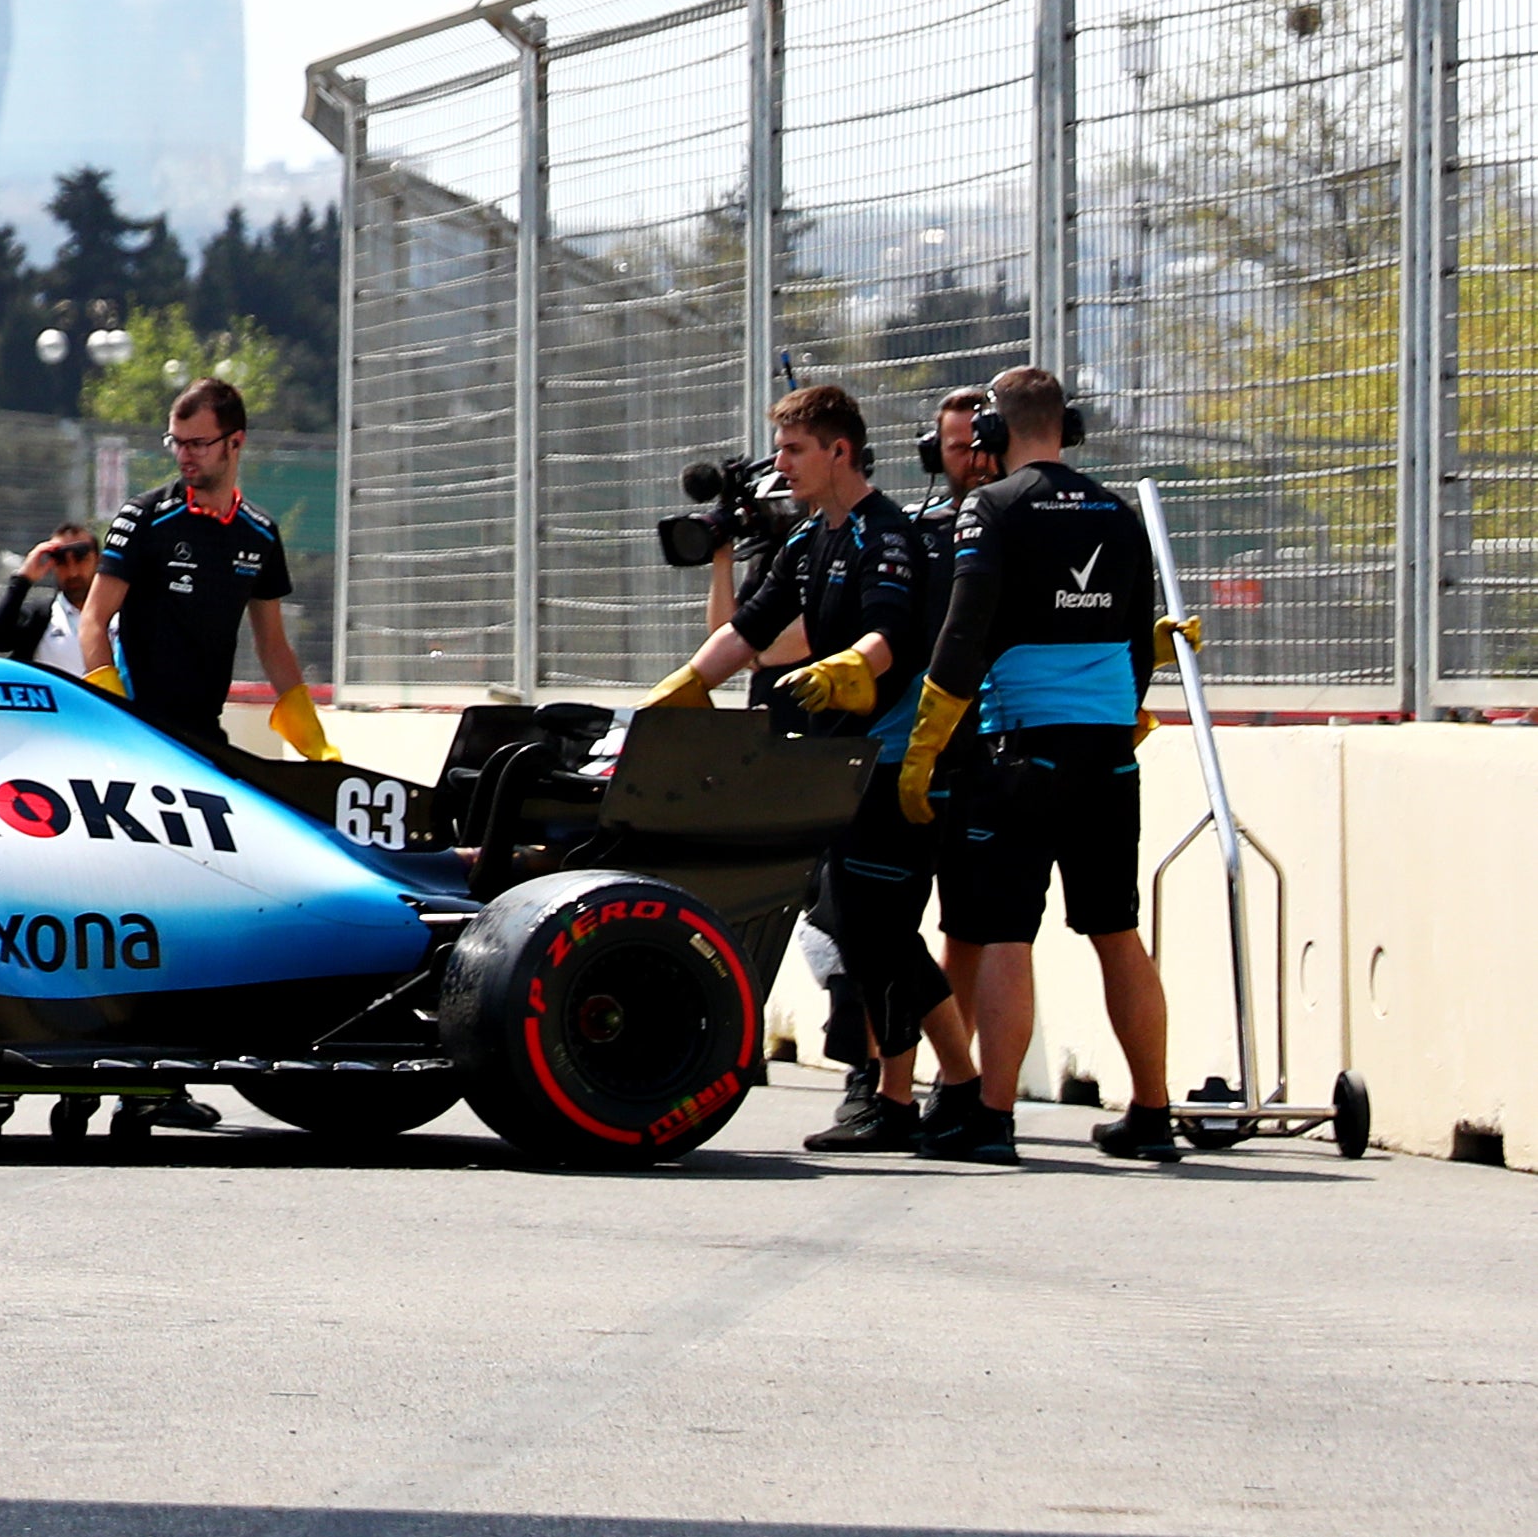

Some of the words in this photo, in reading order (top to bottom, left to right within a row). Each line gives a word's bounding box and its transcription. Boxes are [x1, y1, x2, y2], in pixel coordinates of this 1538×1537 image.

[1055, 589, 1112, 608] Rexona
[335, 776, 408, 851] 63
[528, 976, 548, 1014] P
[545, 899, 668, 968] ZERO
[647, 1070, 742, 1146] PIRELLI
